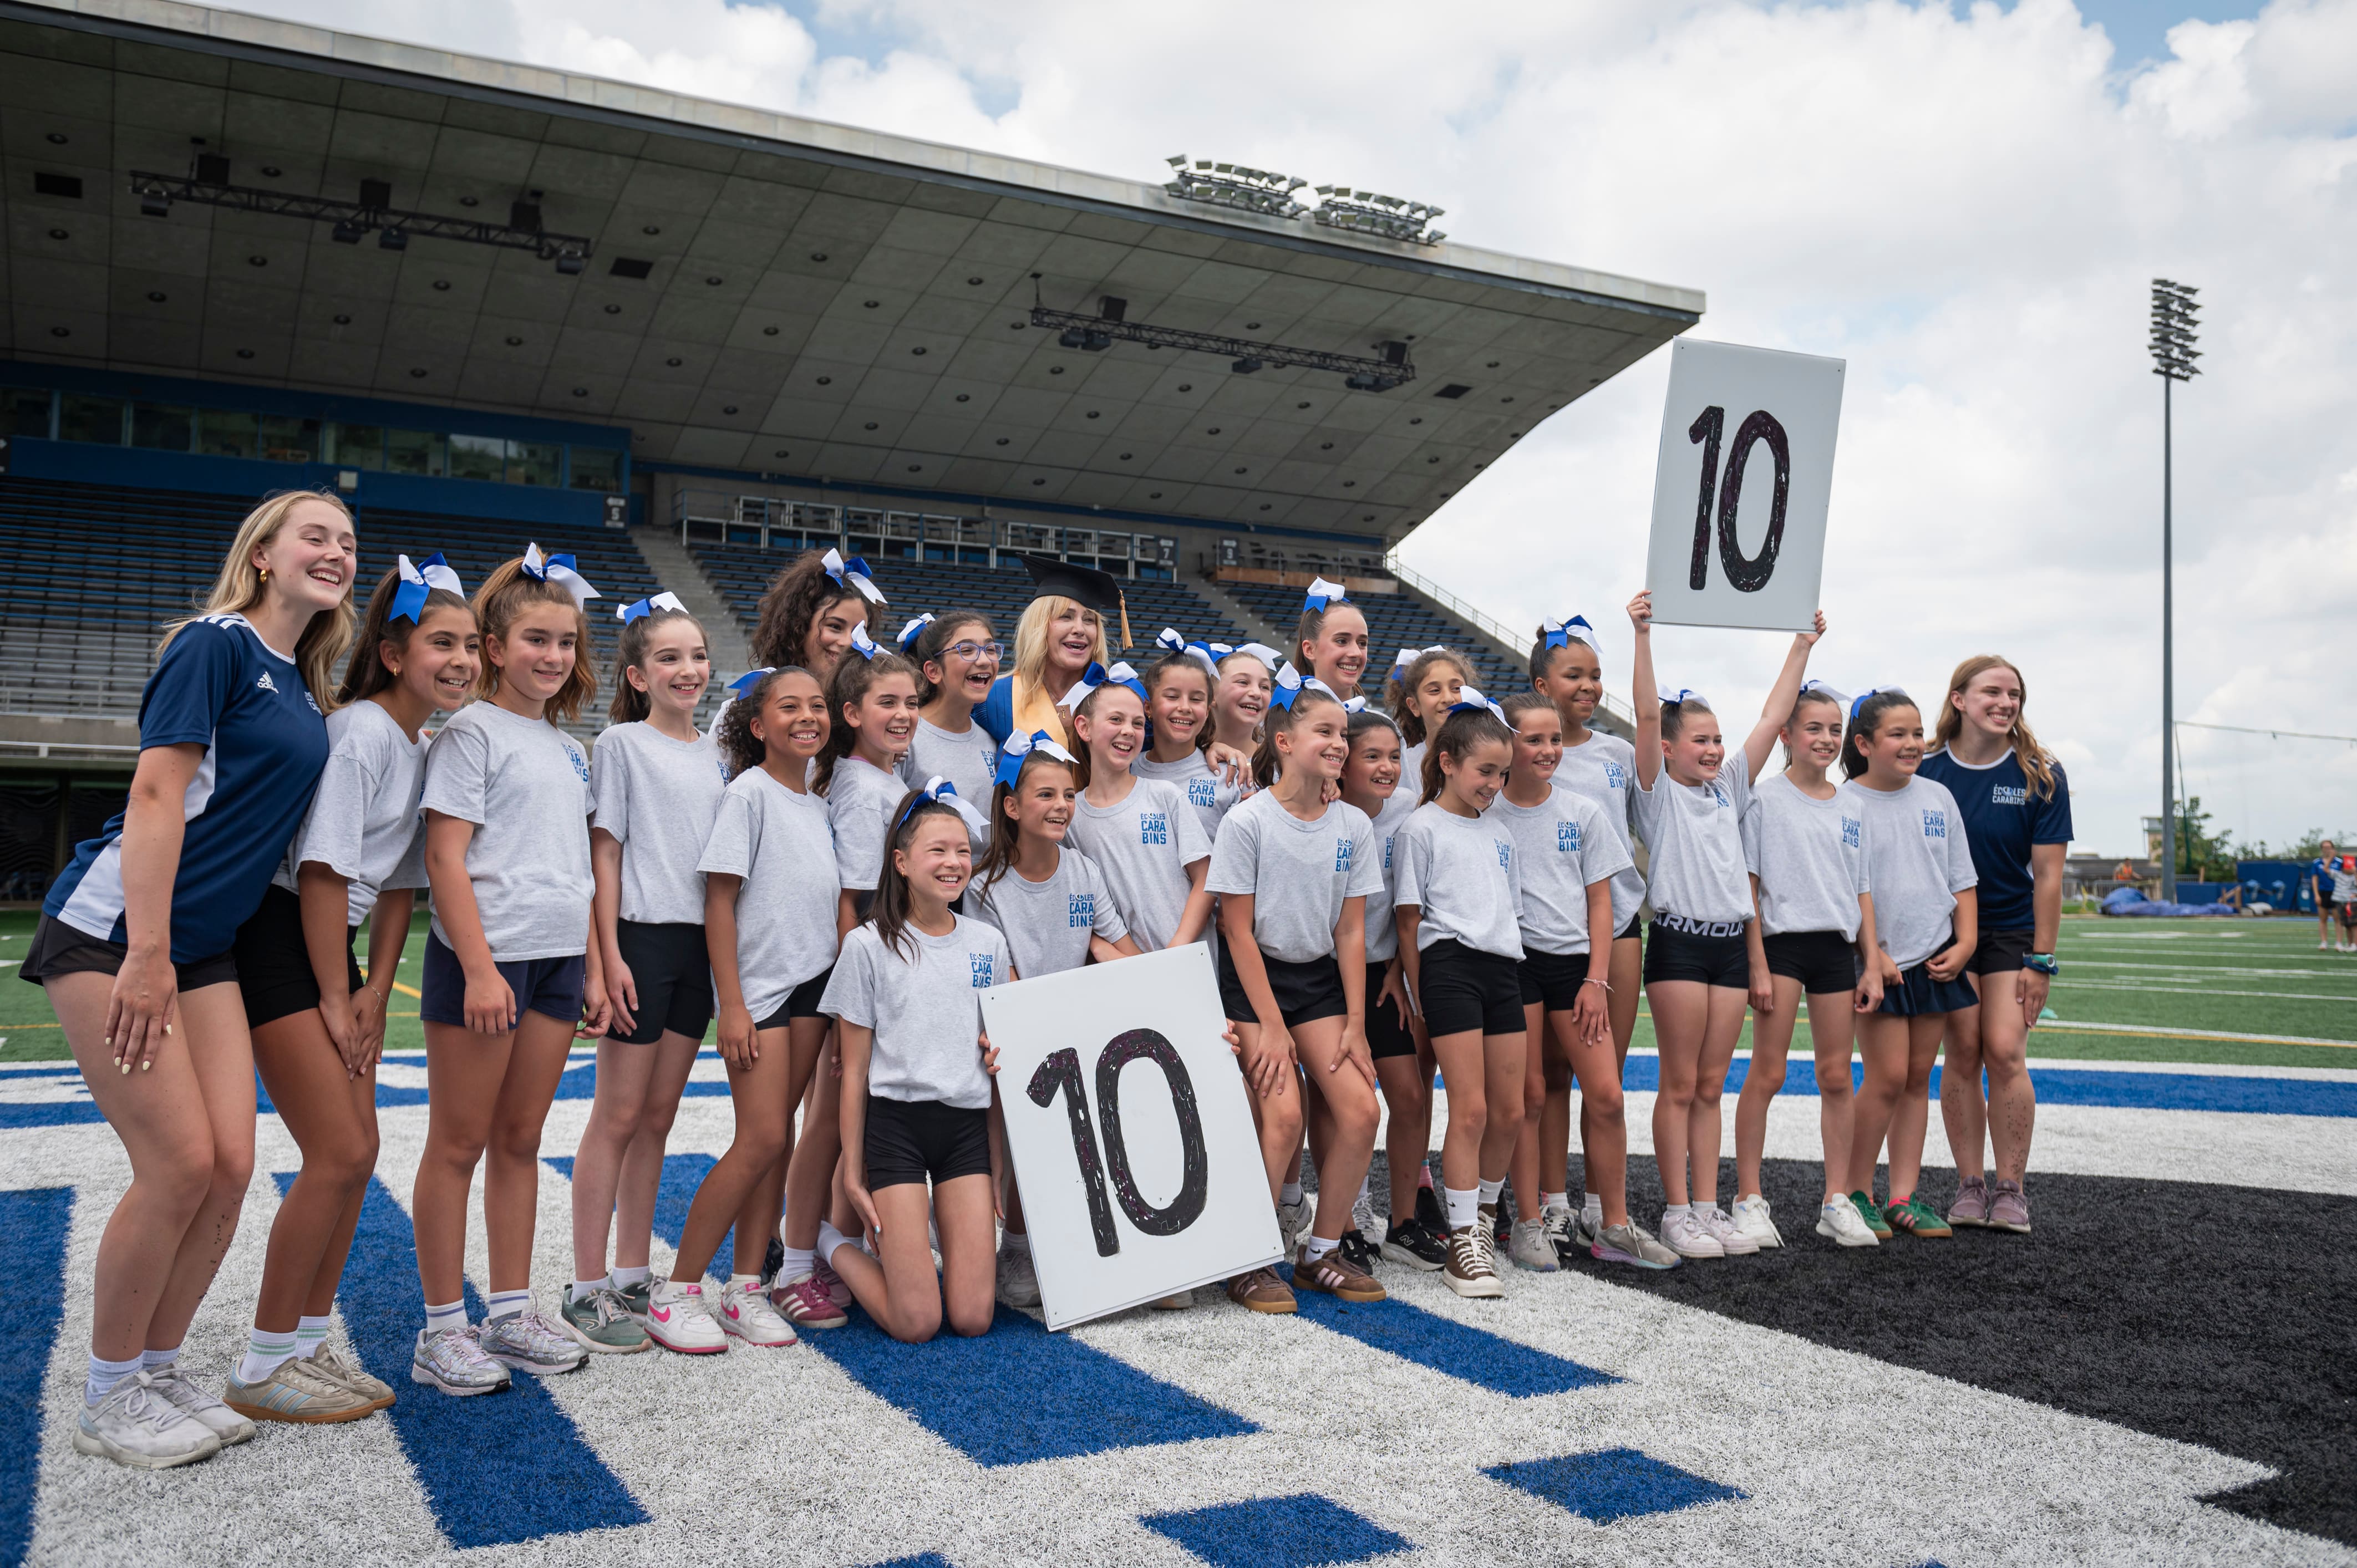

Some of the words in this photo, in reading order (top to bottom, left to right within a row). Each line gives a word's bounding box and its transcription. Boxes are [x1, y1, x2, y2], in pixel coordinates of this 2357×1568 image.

[1689, 405, 1790, 592] 10
[612, 507, 619, 520] 5
[1164, 548, 1170, 559] 7
[984, 757, 994, 766] CA
[1189, 785, 1215, 796] CARA
[1993, 783, 2026, 797] ÉCOLES
[1992, 795, 2025, 806] CARABINS
[1141, 820, 1166, 832] CARA
[1924, 816, 1945, 828] CARA
[1842, 823, 1859, 837] CARA
[1925, 827, 1945, 838] BINS
[1142, 832, 1166, 844] BINS
[1843, 833, 1859, 848] BINS
[1337, 847, 1352, 859] CAR
[1335, 860, 1349, 872] BIN
[1069, 893, 1094, 902] ÉCOLES
[1069, 902, 1094, 914] CARA
[1070, 915, 1094, 928] BINS
[969, 953, 993, 963] ÉCOES
[1025, 1028, 1208, 1258] 10
